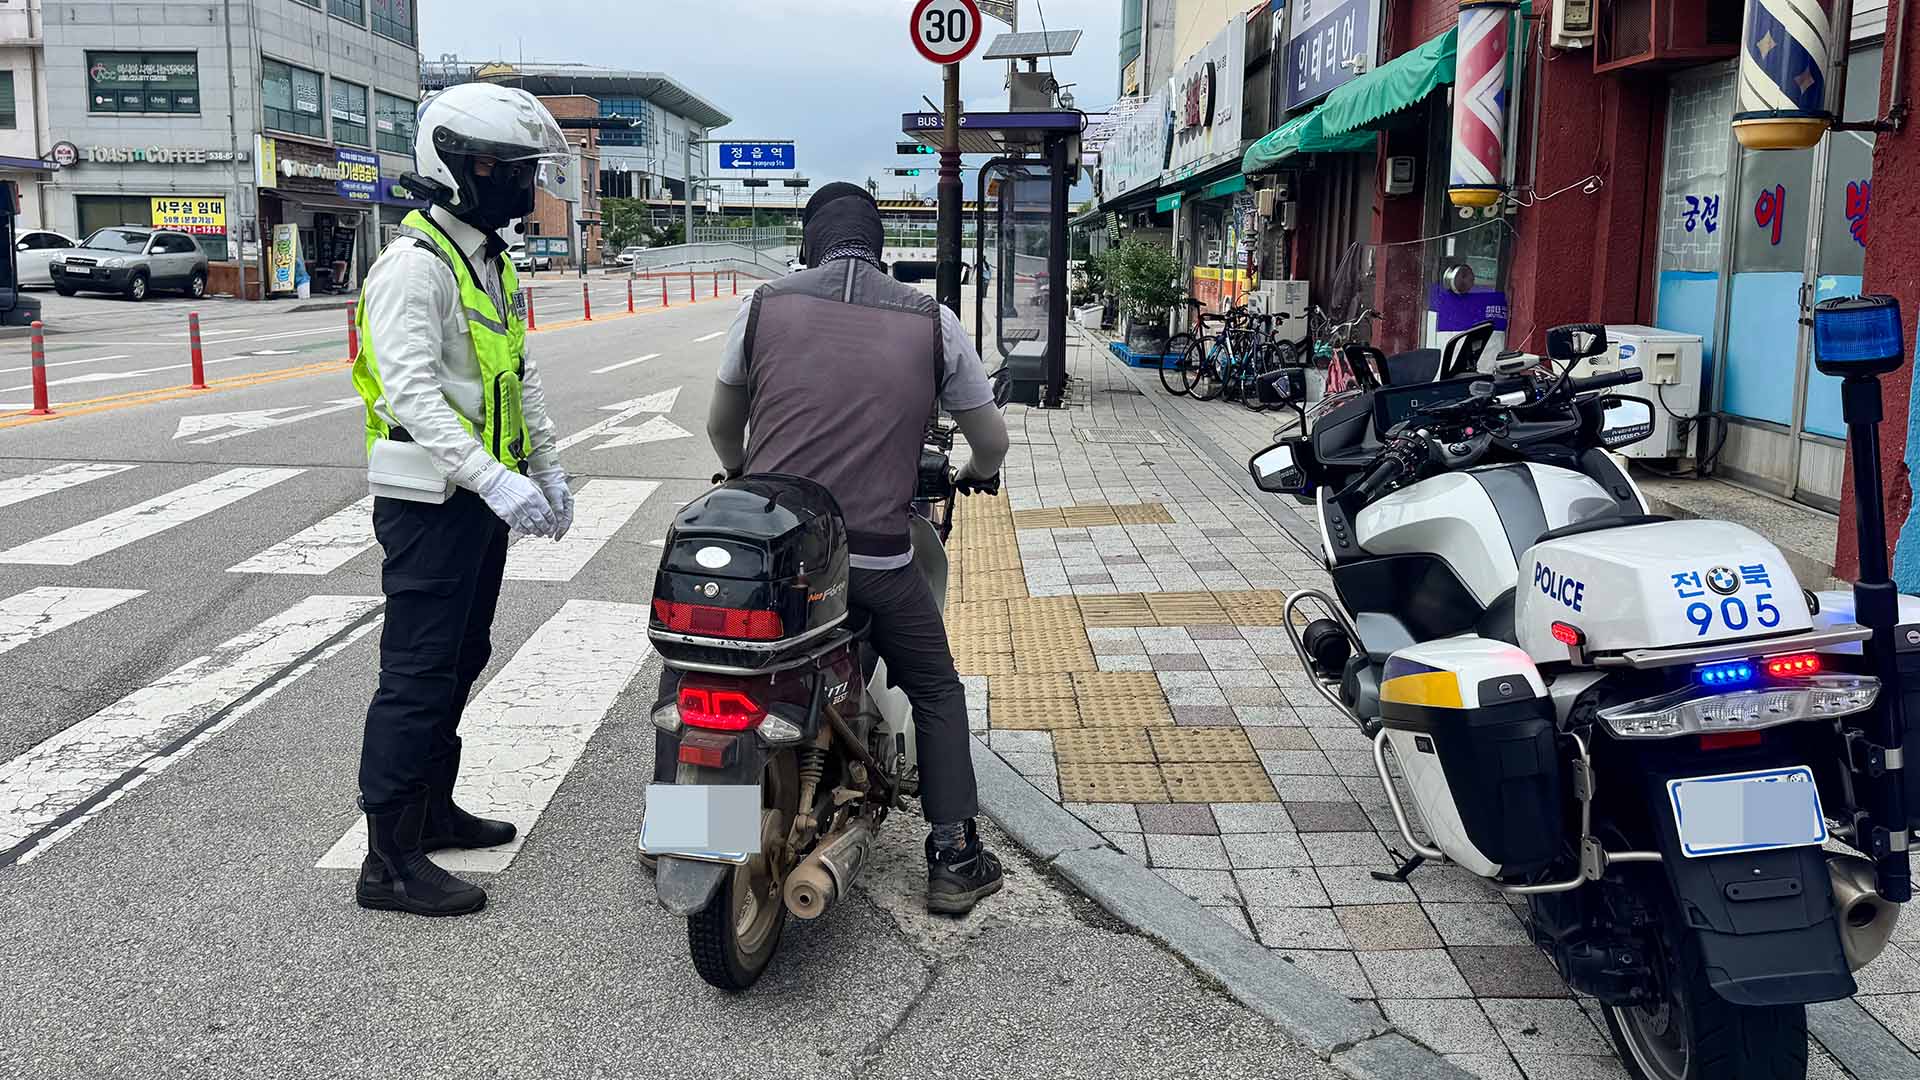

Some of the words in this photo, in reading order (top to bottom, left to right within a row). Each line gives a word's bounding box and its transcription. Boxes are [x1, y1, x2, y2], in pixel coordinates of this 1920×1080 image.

[926, 9, 966, 43] 30
[1298, 8, 1356, 92] 인테리어
[917, 116, 938, 127] BUS
[156, 201, 193, 214] 사무실
[197, 201, 222, 215] 임대
[1682, 194, 1720, 234] 궁전
[1754, 183, 1786, 246] 이
[1534, 561, 1585, 613] POLICE
[1686, 593, 1781, 636] 905
